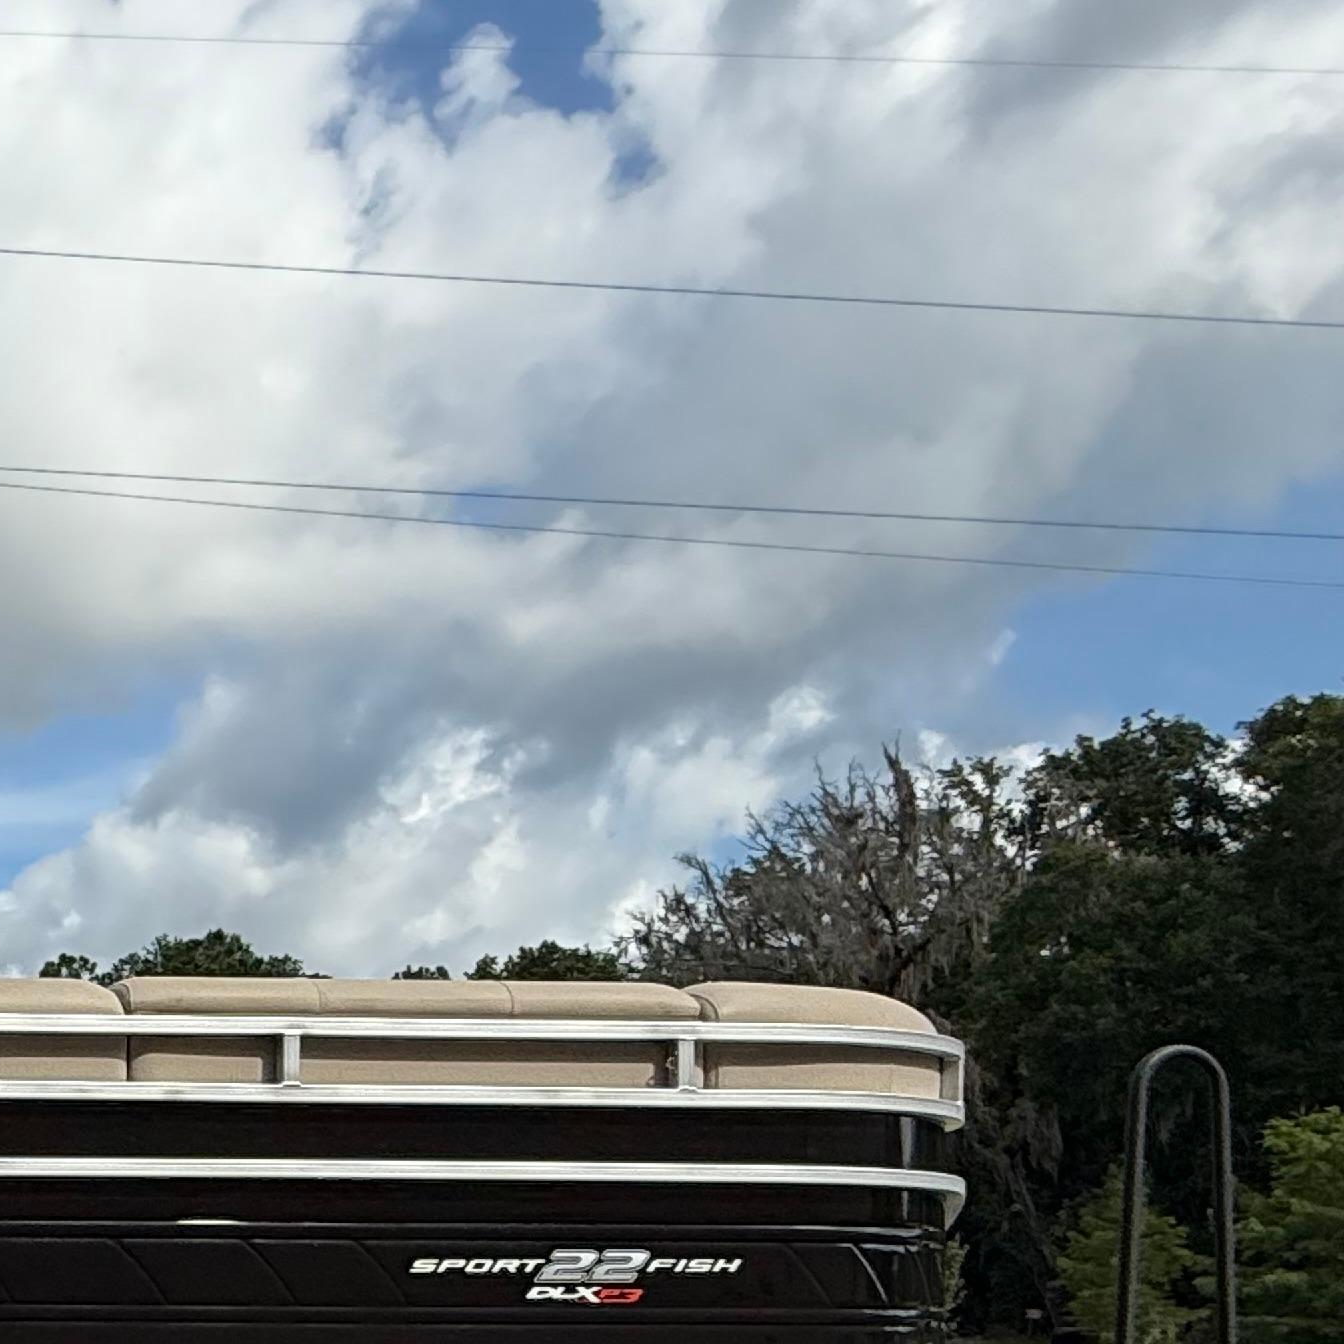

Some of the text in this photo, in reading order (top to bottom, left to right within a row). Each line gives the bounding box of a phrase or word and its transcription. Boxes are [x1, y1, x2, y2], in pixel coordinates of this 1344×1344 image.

[409, 1248, 743, 1284] SPORT 22 FISH
